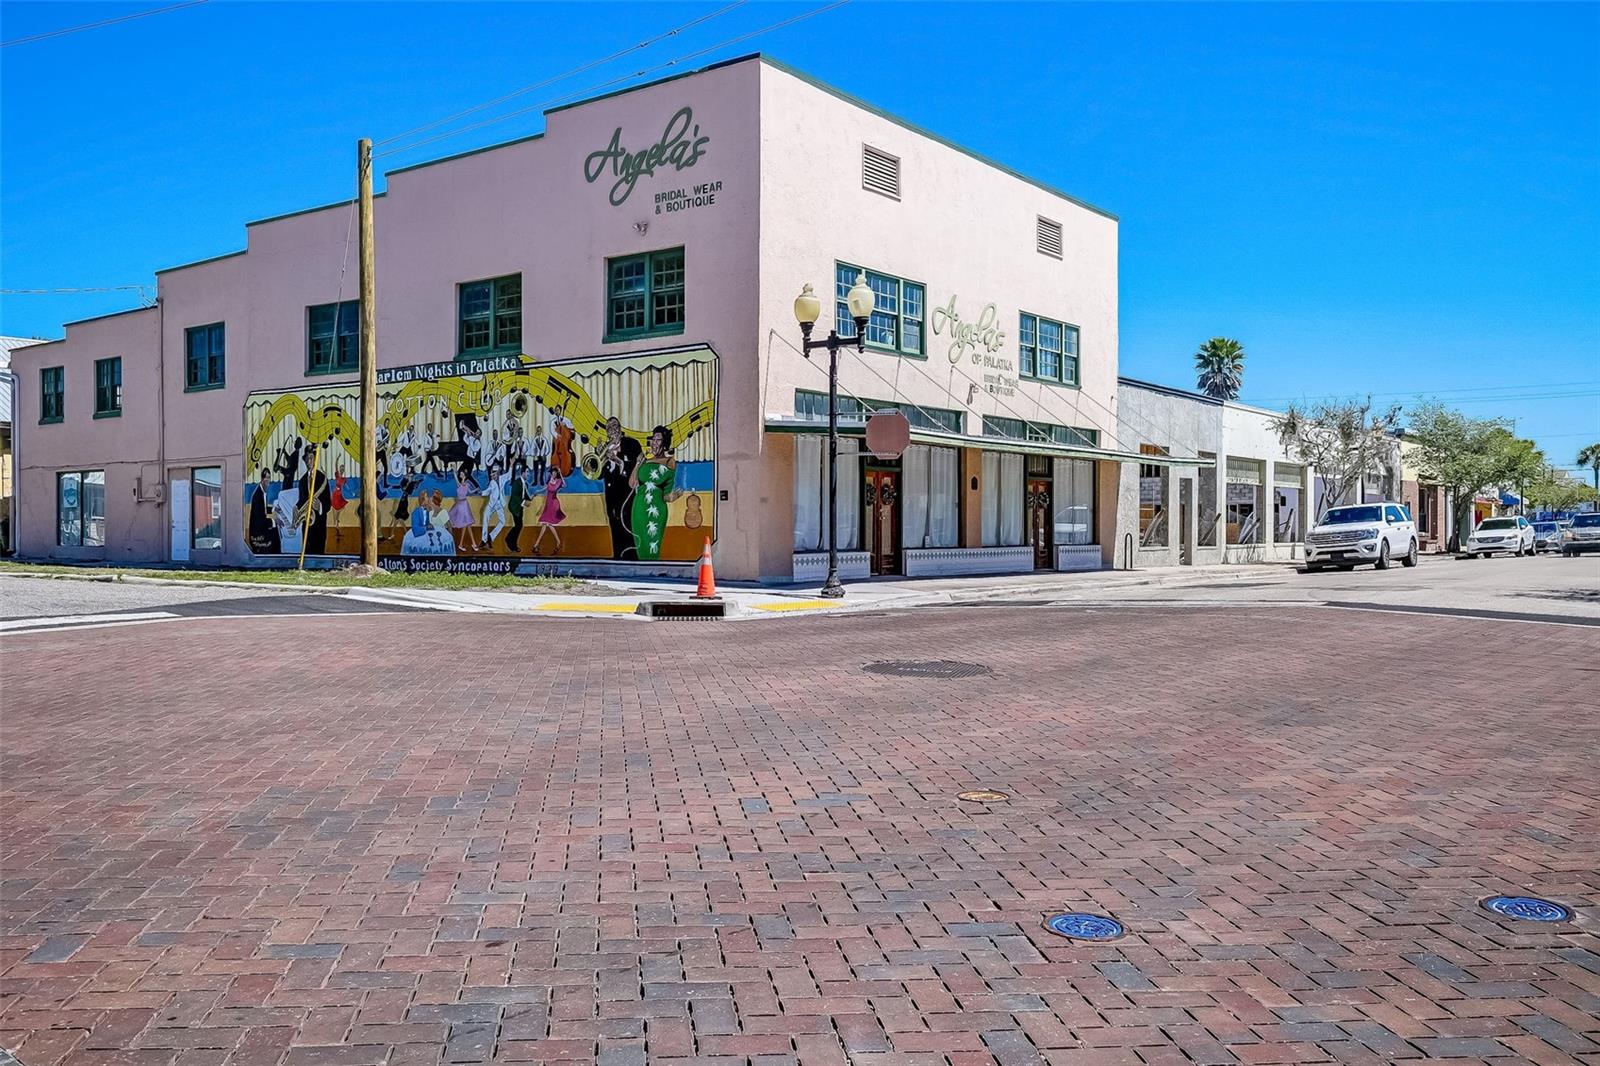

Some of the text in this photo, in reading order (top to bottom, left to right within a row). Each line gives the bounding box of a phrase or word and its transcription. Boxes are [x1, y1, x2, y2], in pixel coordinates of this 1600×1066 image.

[584, 106, 710, 206] Angela's
[655, 181, 723, 203] BRIDAL WEAR
[655, 194, 715, 215] & BOUTIQUE
[931, 294, 1006, 364] Angela's
[971, 353, 1014, 372] OF PALATKA
[376, 369, 412, 384] arlem
[415, 365, 453, 381] Nights
[456, 363, 467, 375] in
[385, 394, 449, 413] COTTON
[378, 558, 511, 572] elton's Society Syncopators
